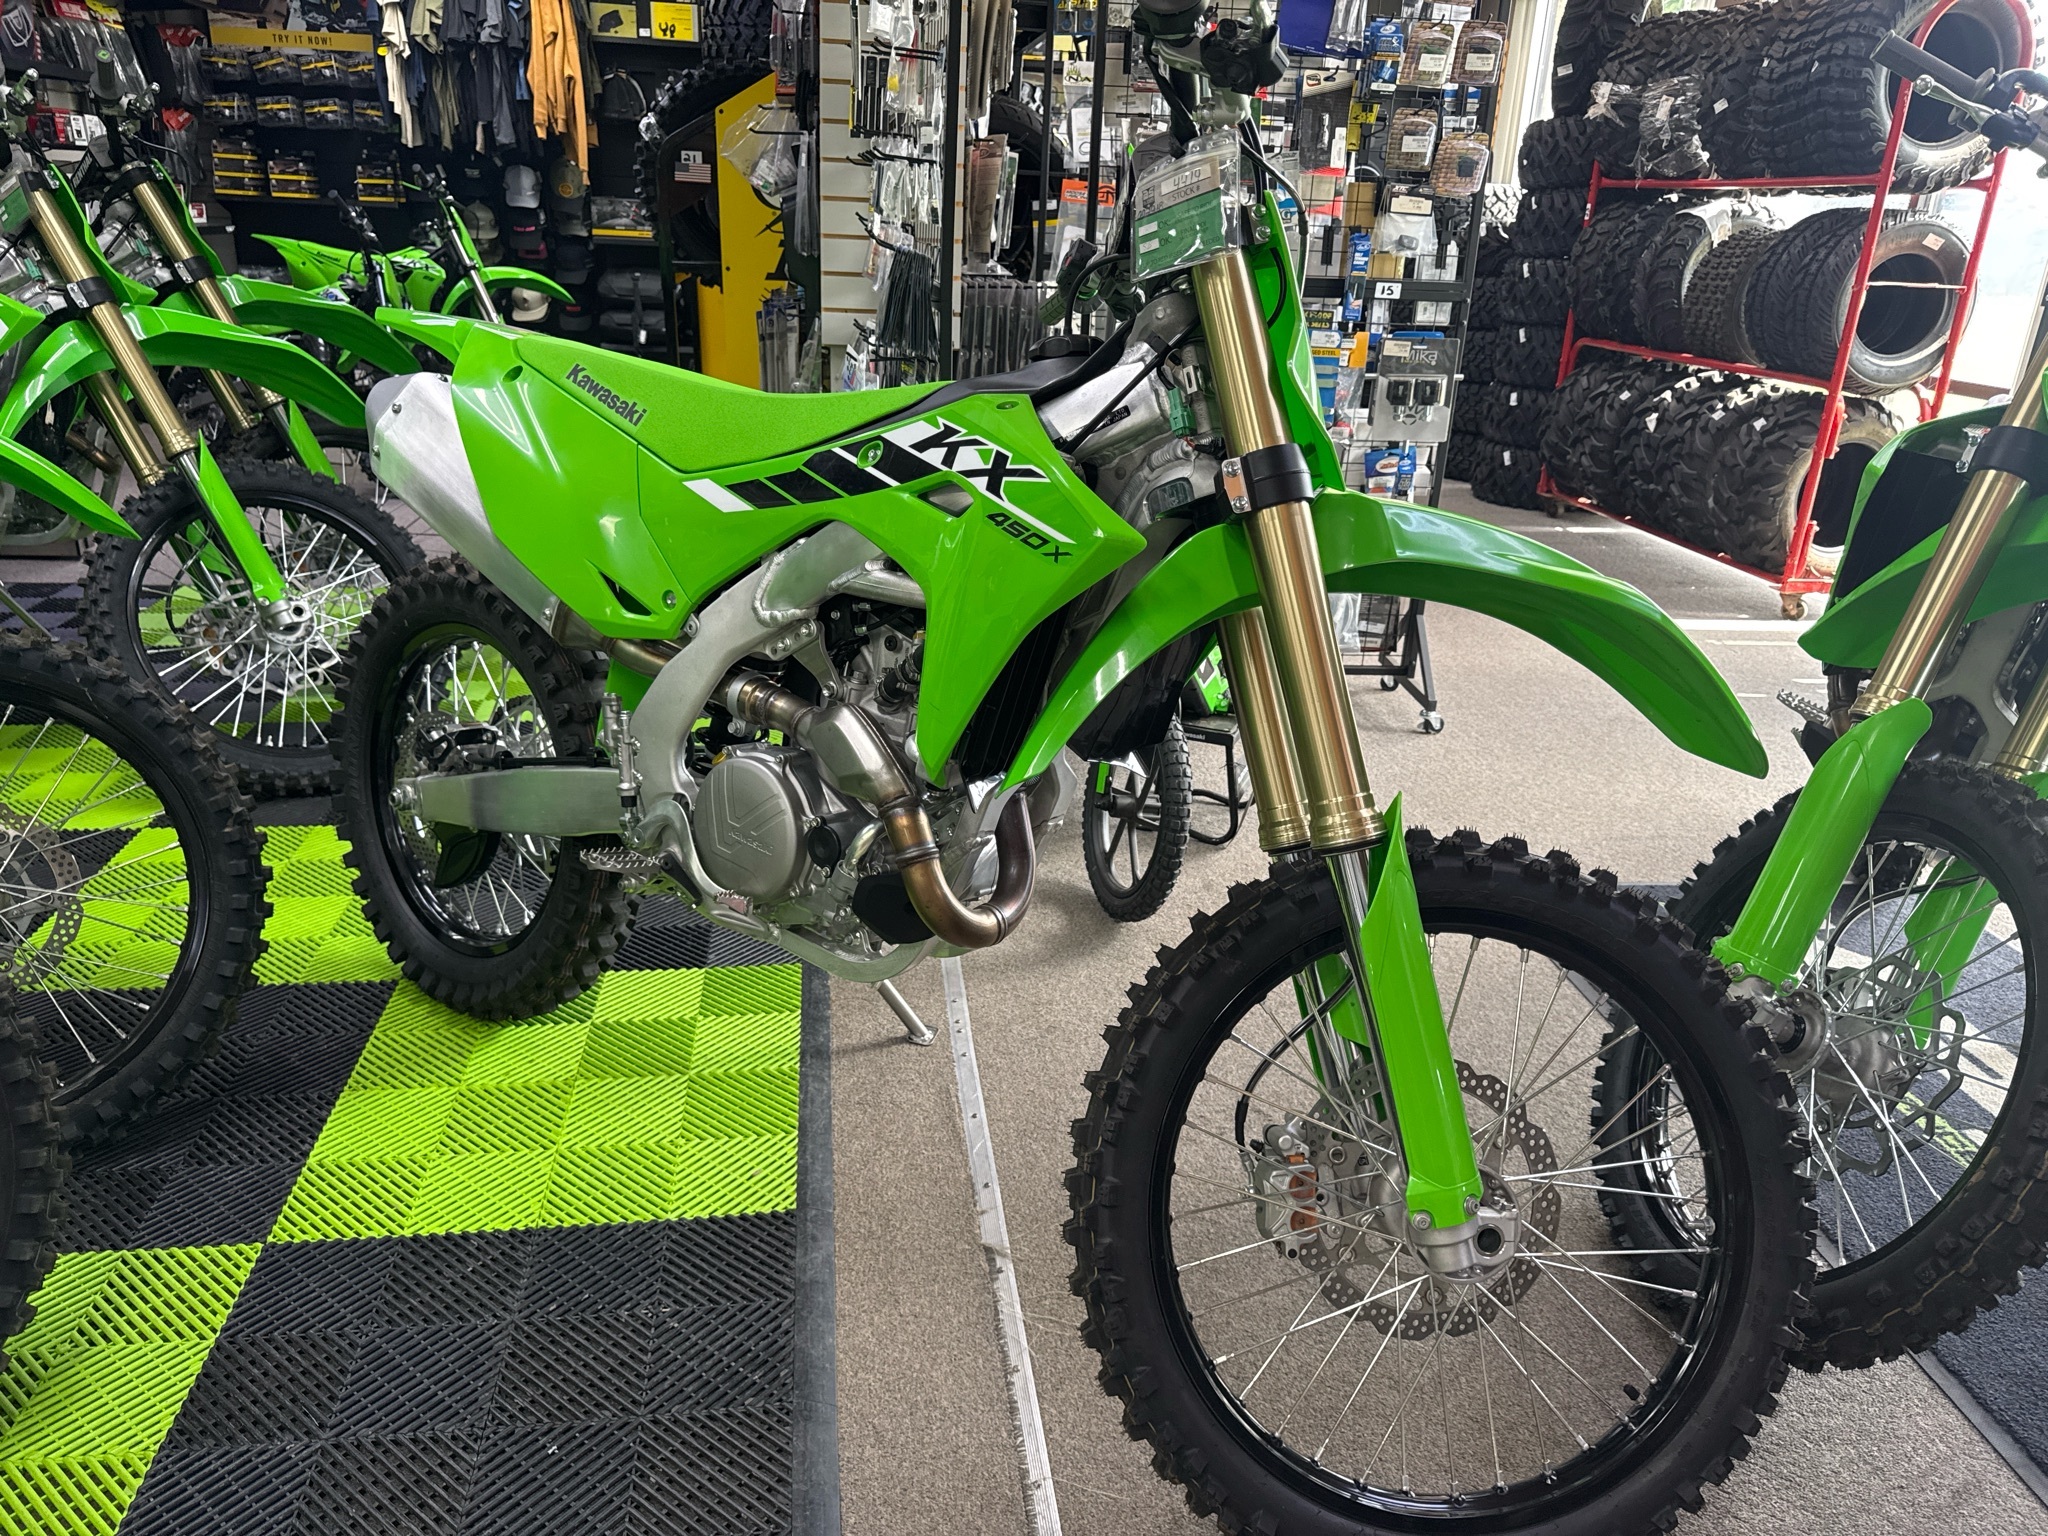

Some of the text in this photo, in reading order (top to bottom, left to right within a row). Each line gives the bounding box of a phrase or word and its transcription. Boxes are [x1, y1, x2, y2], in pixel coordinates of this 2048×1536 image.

[272, 33, 333, 46] TRY IT NOW!
[1171, 186, 1195, 201] STOCK
[1158, 235, 1172, 247] OK
[1380, 285, 1395, 296] 15
[565, 363, 648, 427] Kawasaki
[907, 421, 1048, 503] KX
